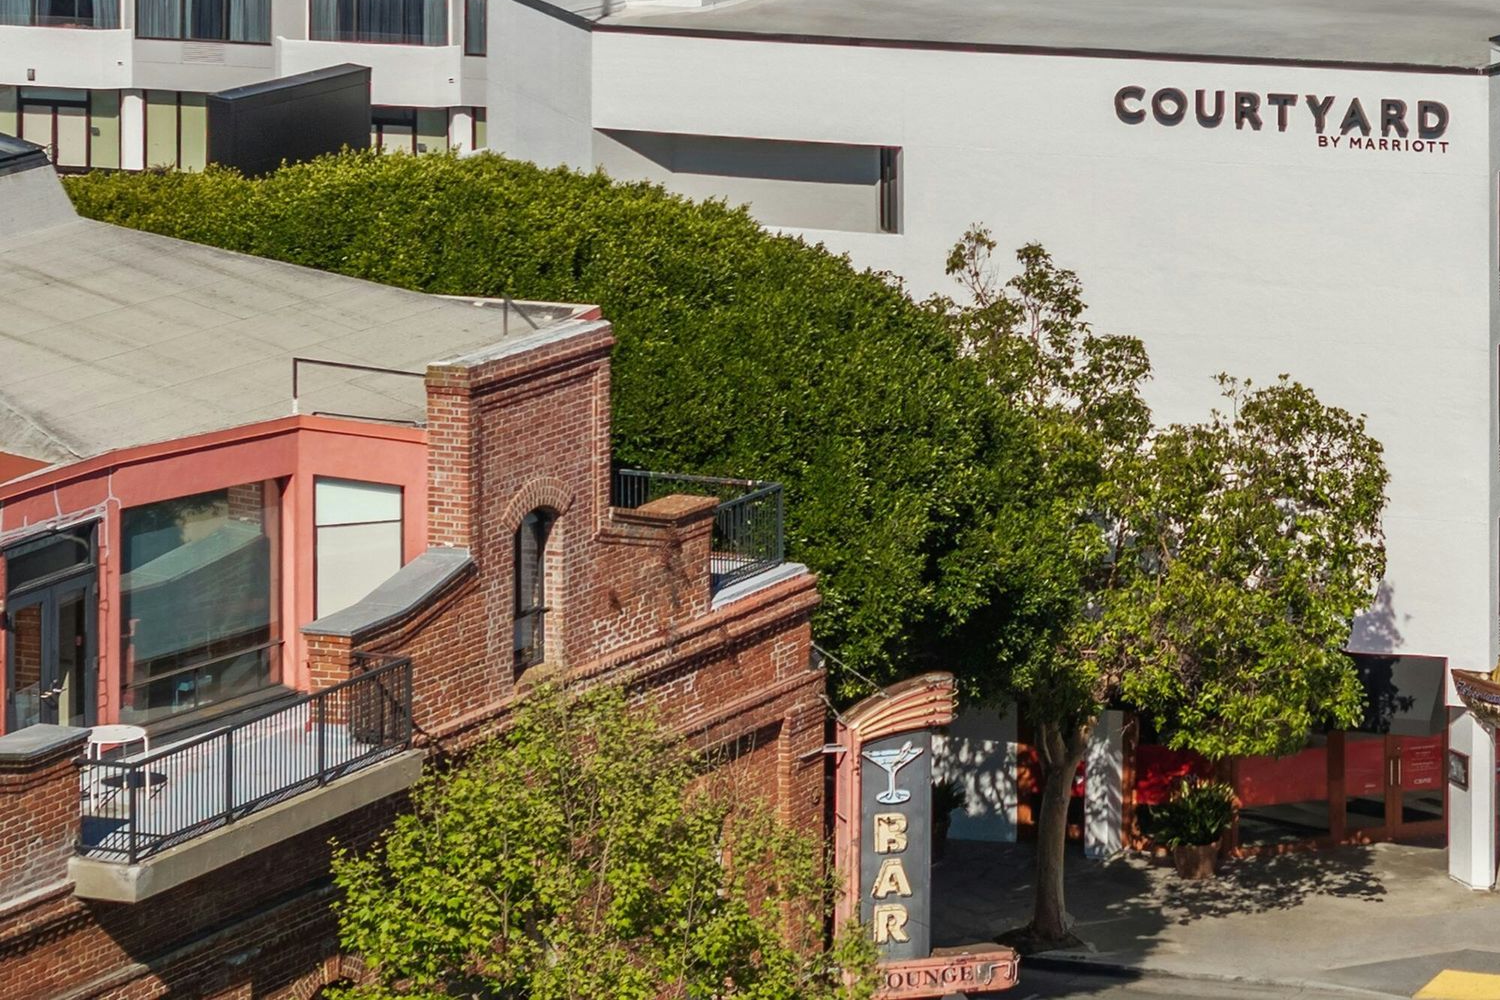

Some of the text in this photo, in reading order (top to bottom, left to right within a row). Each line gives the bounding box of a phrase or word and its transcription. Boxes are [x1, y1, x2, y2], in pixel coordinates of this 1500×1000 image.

[1113, 85, 1450, 139] COURTYARD
[1317, 135, 1450, 153] BY MARRIOTT
[870, 812, 913, 945] BAR
[887, 965, 974, 989] OUNGE
